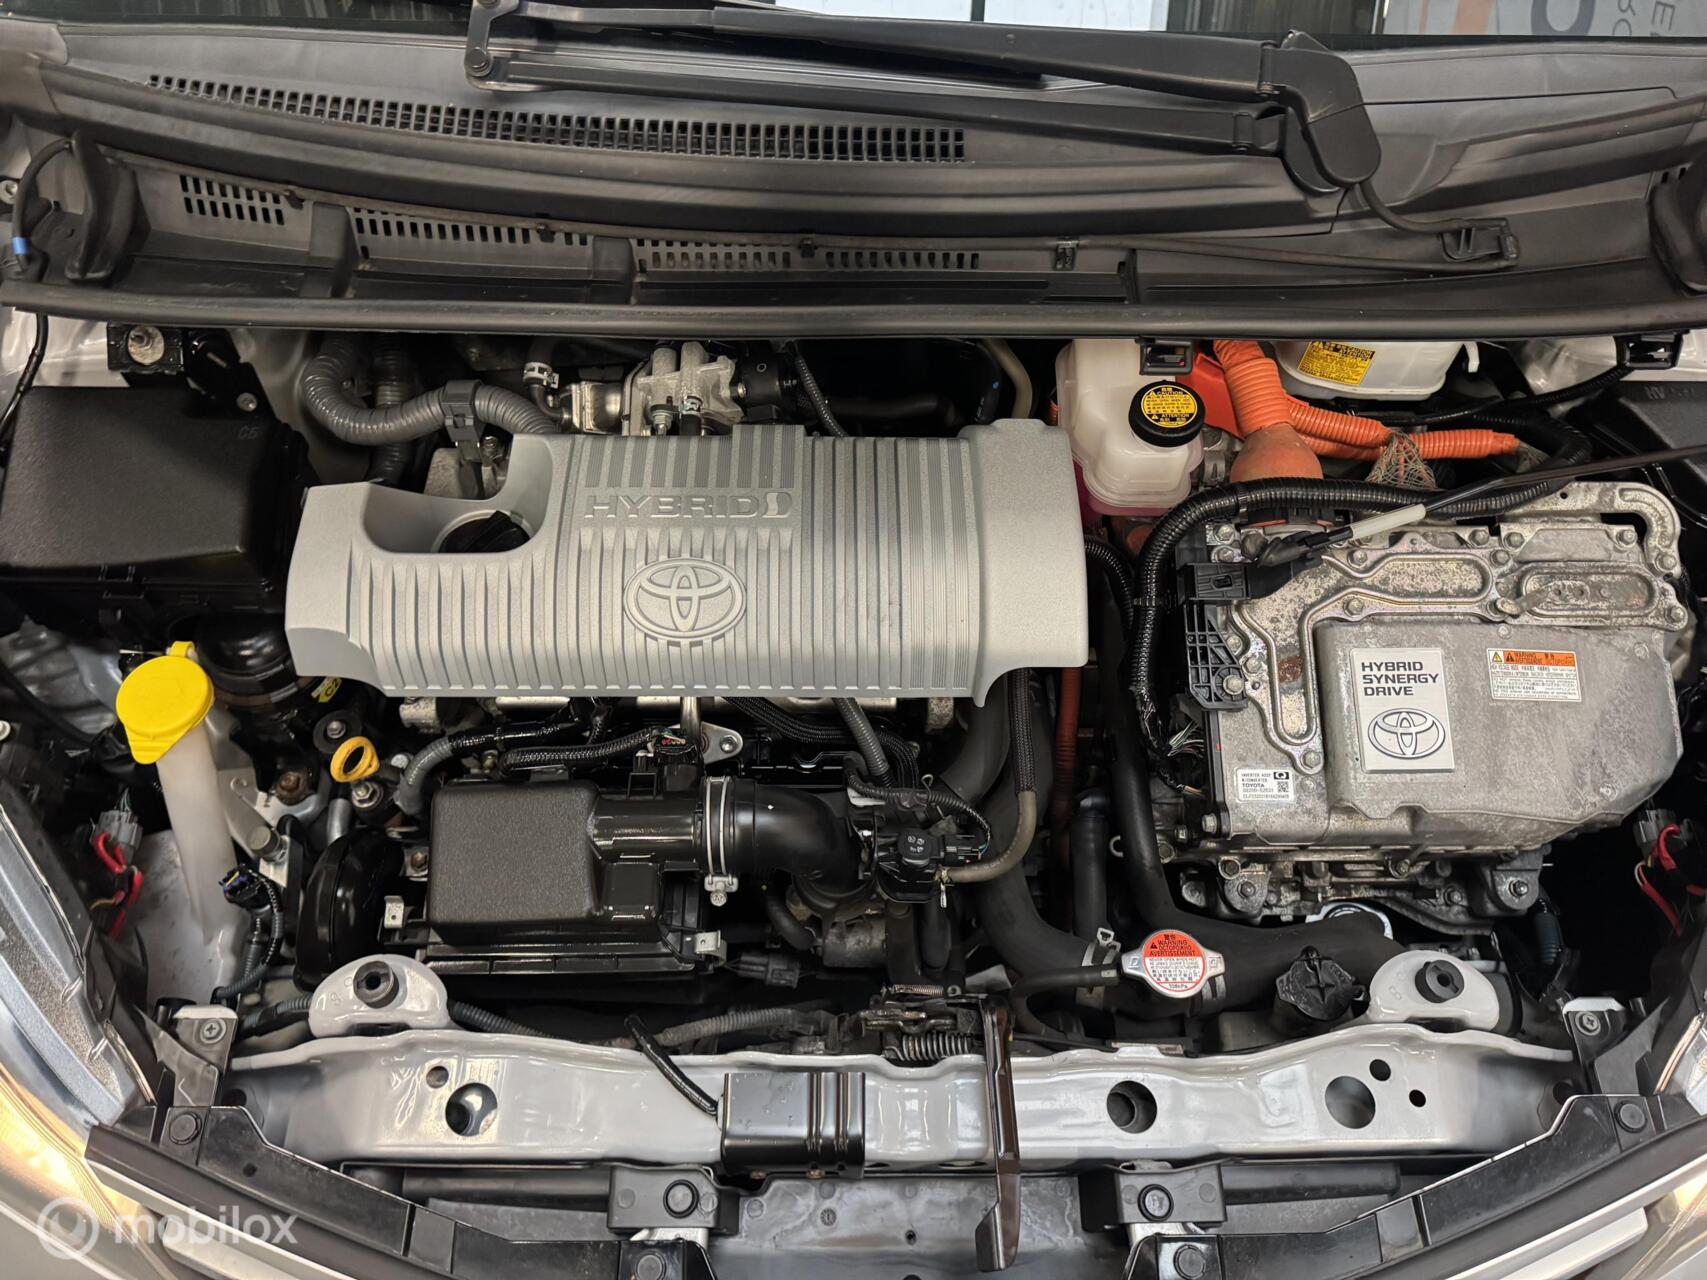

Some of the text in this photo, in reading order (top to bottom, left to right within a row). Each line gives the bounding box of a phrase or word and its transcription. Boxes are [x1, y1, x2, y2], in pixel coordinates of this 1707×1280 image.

[584, 494, 760, 519] HYBRID
[1361, 661, 1424, 672] HYBRID
[1362, 673, 1439, 685] SYNERGY
[1363, 686, 1414, 697] DRIVE
